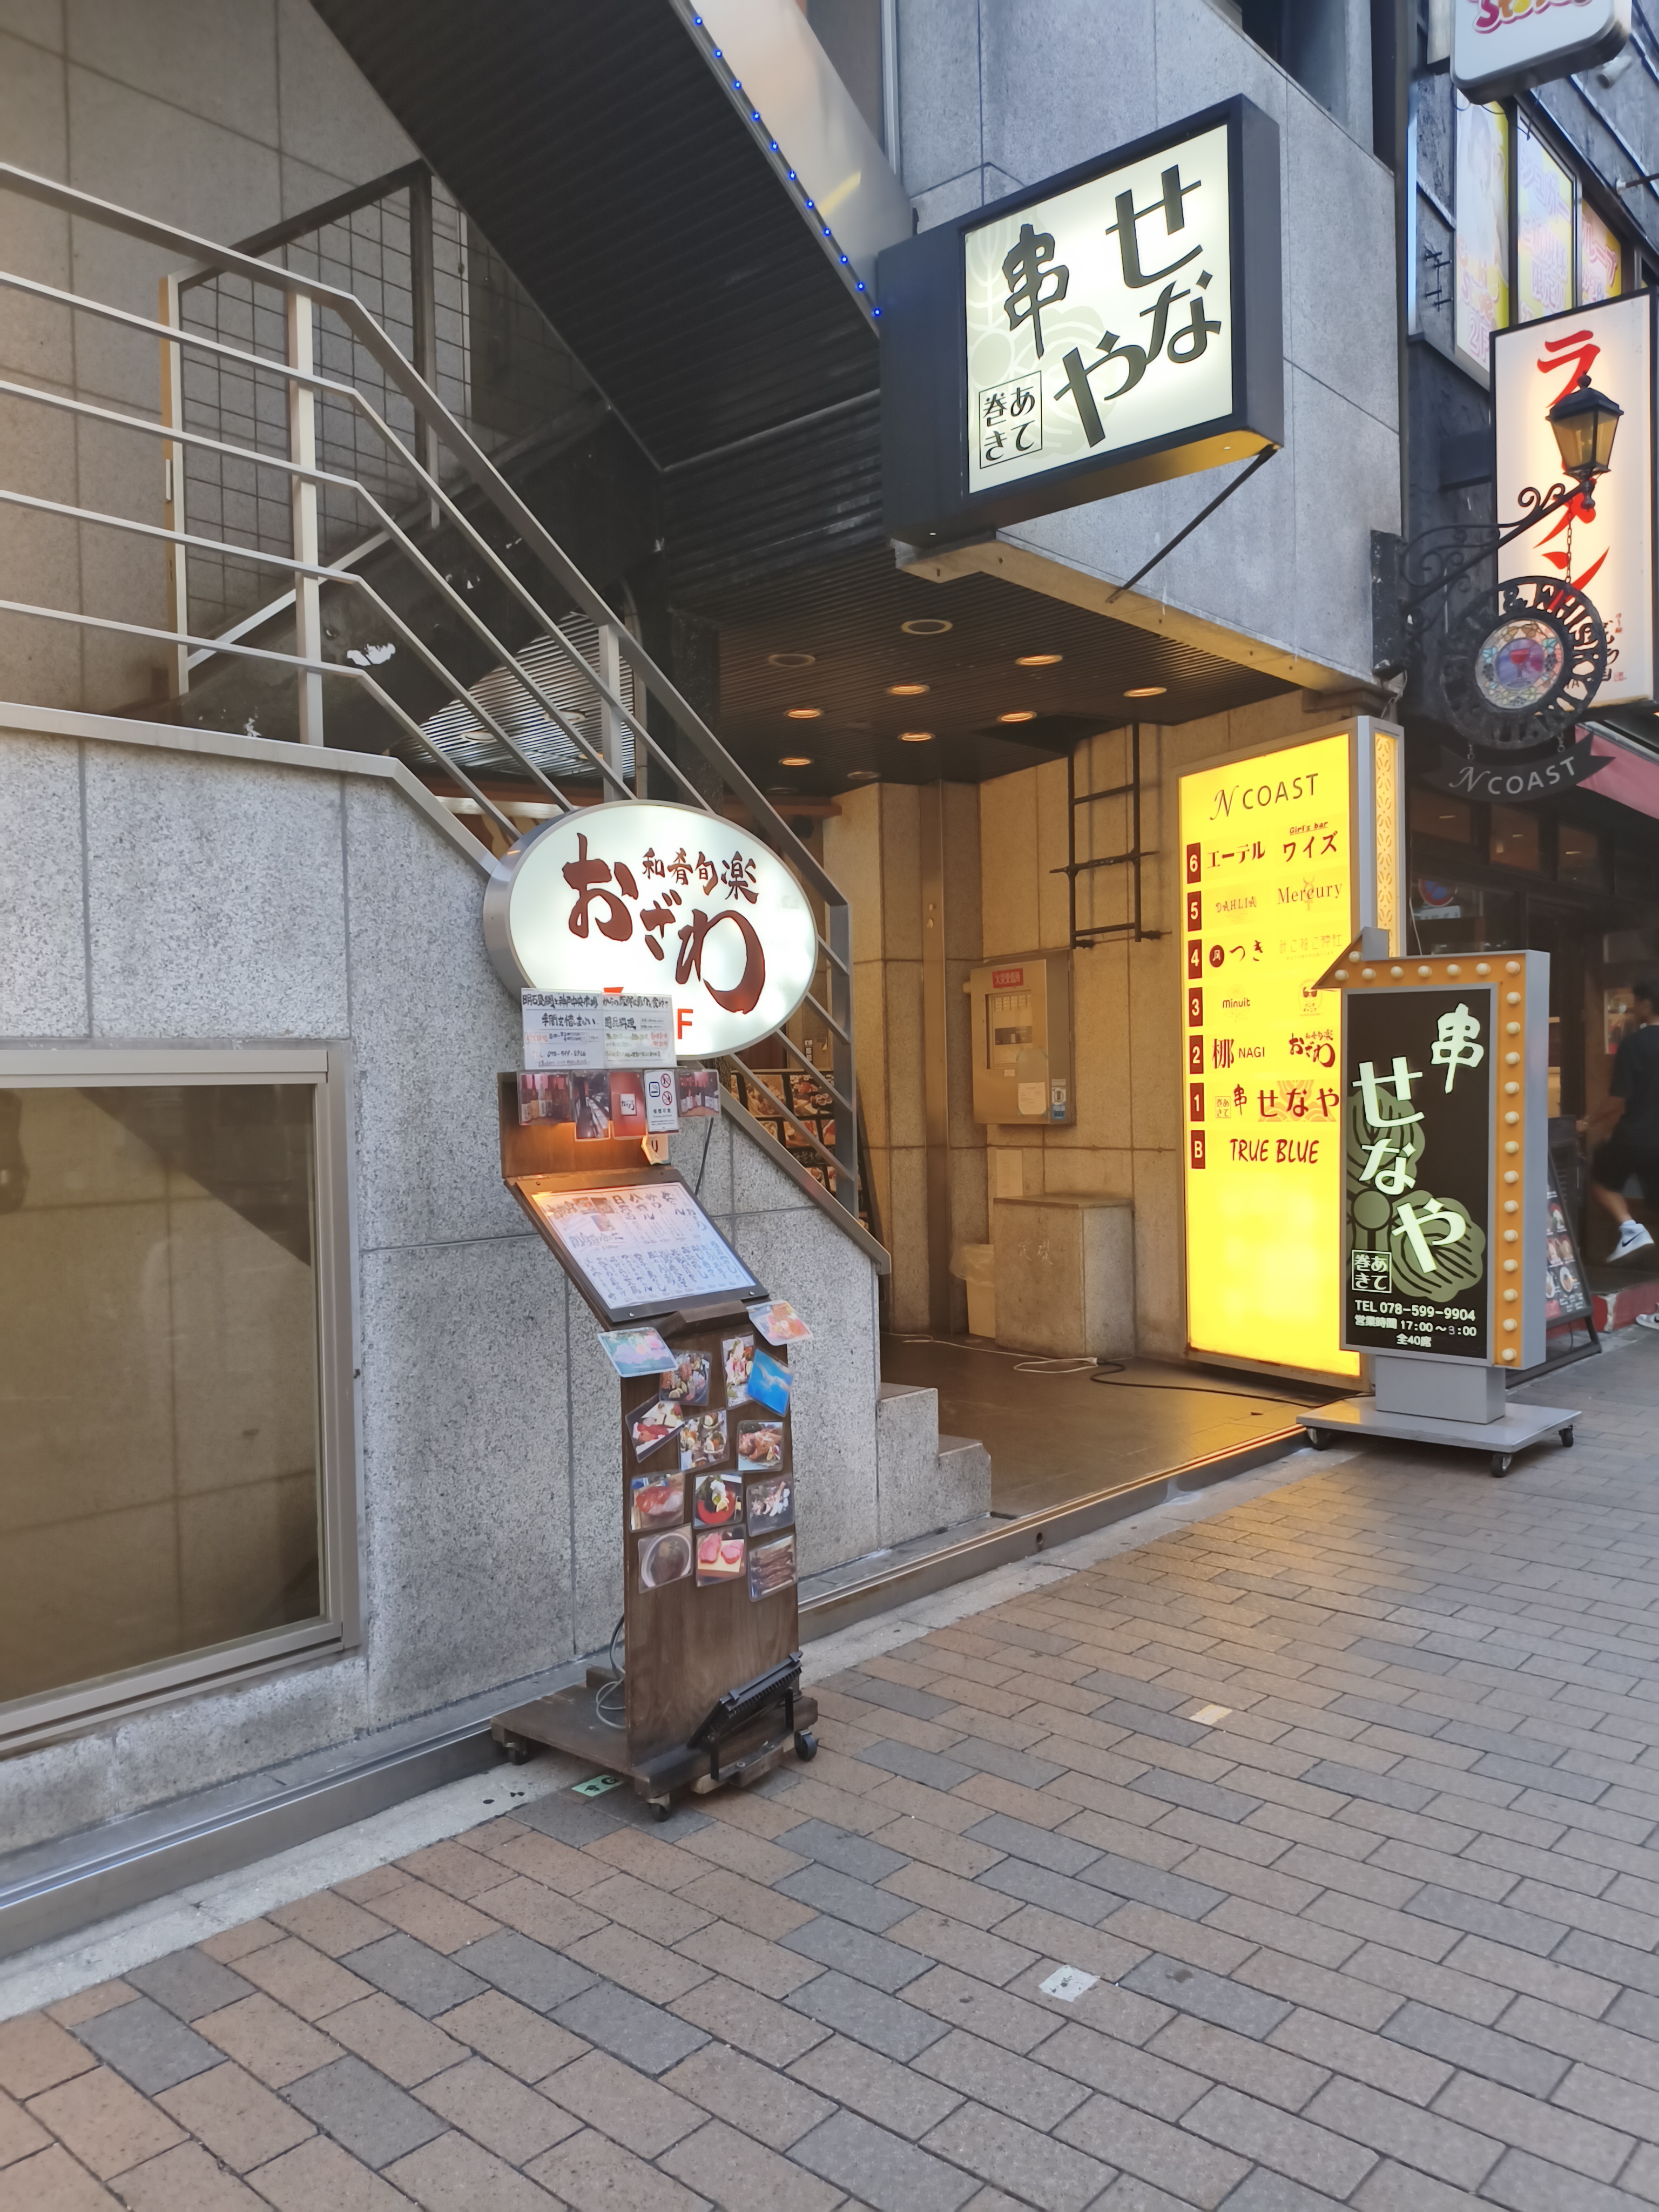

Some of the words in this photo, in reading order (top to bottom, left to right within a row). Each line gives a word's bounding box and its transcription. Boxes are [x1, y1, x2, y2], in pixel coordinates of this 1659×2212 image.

[1003, 224, 1069, 359] 串
[1054, 165, 1221, 448] せなや
[983, 394, 1007, 461] 巻き
[1010, 387, 1035, 451] あて
[1533, 330, 1611, 612] ラメン
[1488, 757, 1575, 794] COAST
[1242, 772, 1319, 810] COAST
[1314, 821, 1328, 830] bar
[1206, 841, 1266, 868] エーテル
[1283, 830, 1338, 862] ワイズ
[1190, 854, 1198, 873] 6
[1216, 896, 1257, 913] DAHLIA
[1278, 882, 1343, 905] Mercury
[562, 832, 766, 1015] おざわ
[1191, 901, 1199, 920] 5
[1191, 949, 1199, 967] 4
[1229, 940, 1263, 962] つき
[1192, 998, 1200, 1016] 3
[1193, 1046, 1201, 1064] 2
[1239, 1047, 1265, 1058] NAGI
[1289, 1033, 1336, 1068] おざわ
[1431, 1003, 1484, 1094] 串
[1193, 1094, 1200, 1112] 1
[1257, 1088, 1339, 1117] せなや
[1195, 1141, 1203, 1158] B
[1230, 1138, 1269, 1163] TRUE
[1276, 1139, 1319, 1163] BLUE
[1352, 1056, 1466, 1273] せなや
[1354, 1254, 1371, 1289] 巻き
[1371, 1256, 1388, 1290] あて
[1354, 1299, 1378, 1312] TEL
[1379, 1301, 1476, 1321] 078-599-9904
[1354, 1314, 1398, 1330] 営業時間
[1396, 1333, 1432, 1347] 全40席
